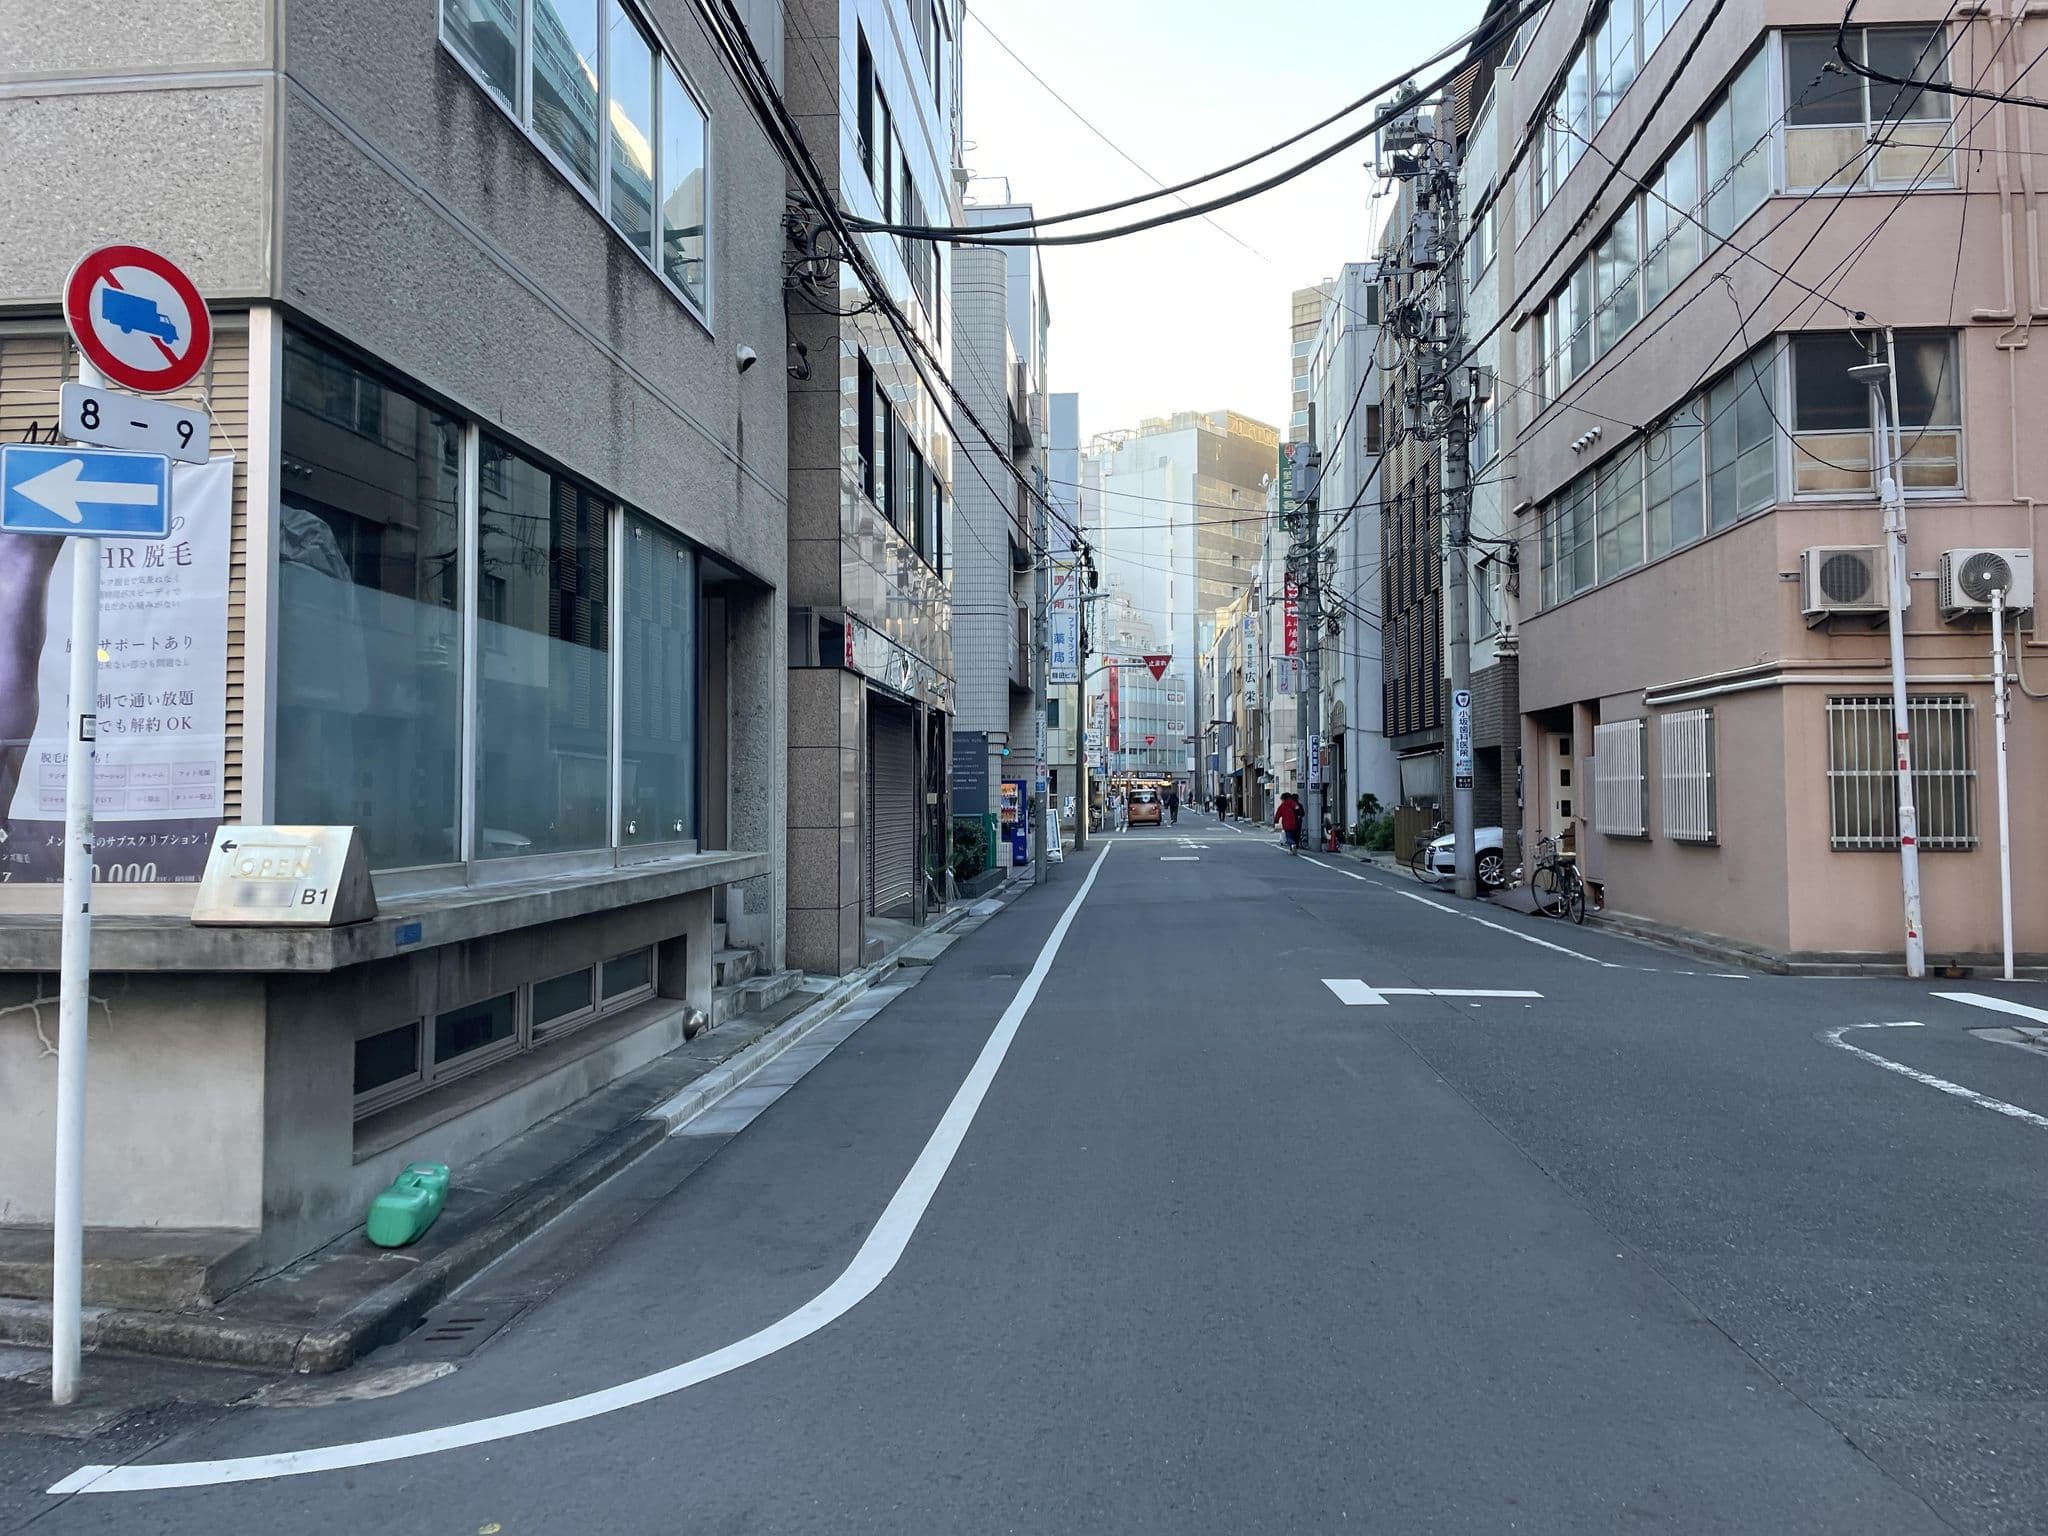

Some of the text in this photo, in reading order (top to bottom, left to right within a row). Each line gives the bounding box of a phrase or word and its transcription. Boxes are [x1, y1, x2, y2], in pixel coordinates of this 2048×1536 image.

[80, 398, 101, 430] 8
[176, 420, 194, 450] 9
[143, 541, 193, 568] 脱毛
[66, 635, 193, 652] サポートあり
[1053, 633, 1065, 663] 薬局
[66, 690, 194, 709] 制で通い放題
[66, 717, 161, 734] でも解約
[167, 716, 192, 731] OK
[240, 858, 309, 878] OPEN
[301, 888, 329, 905] B1
